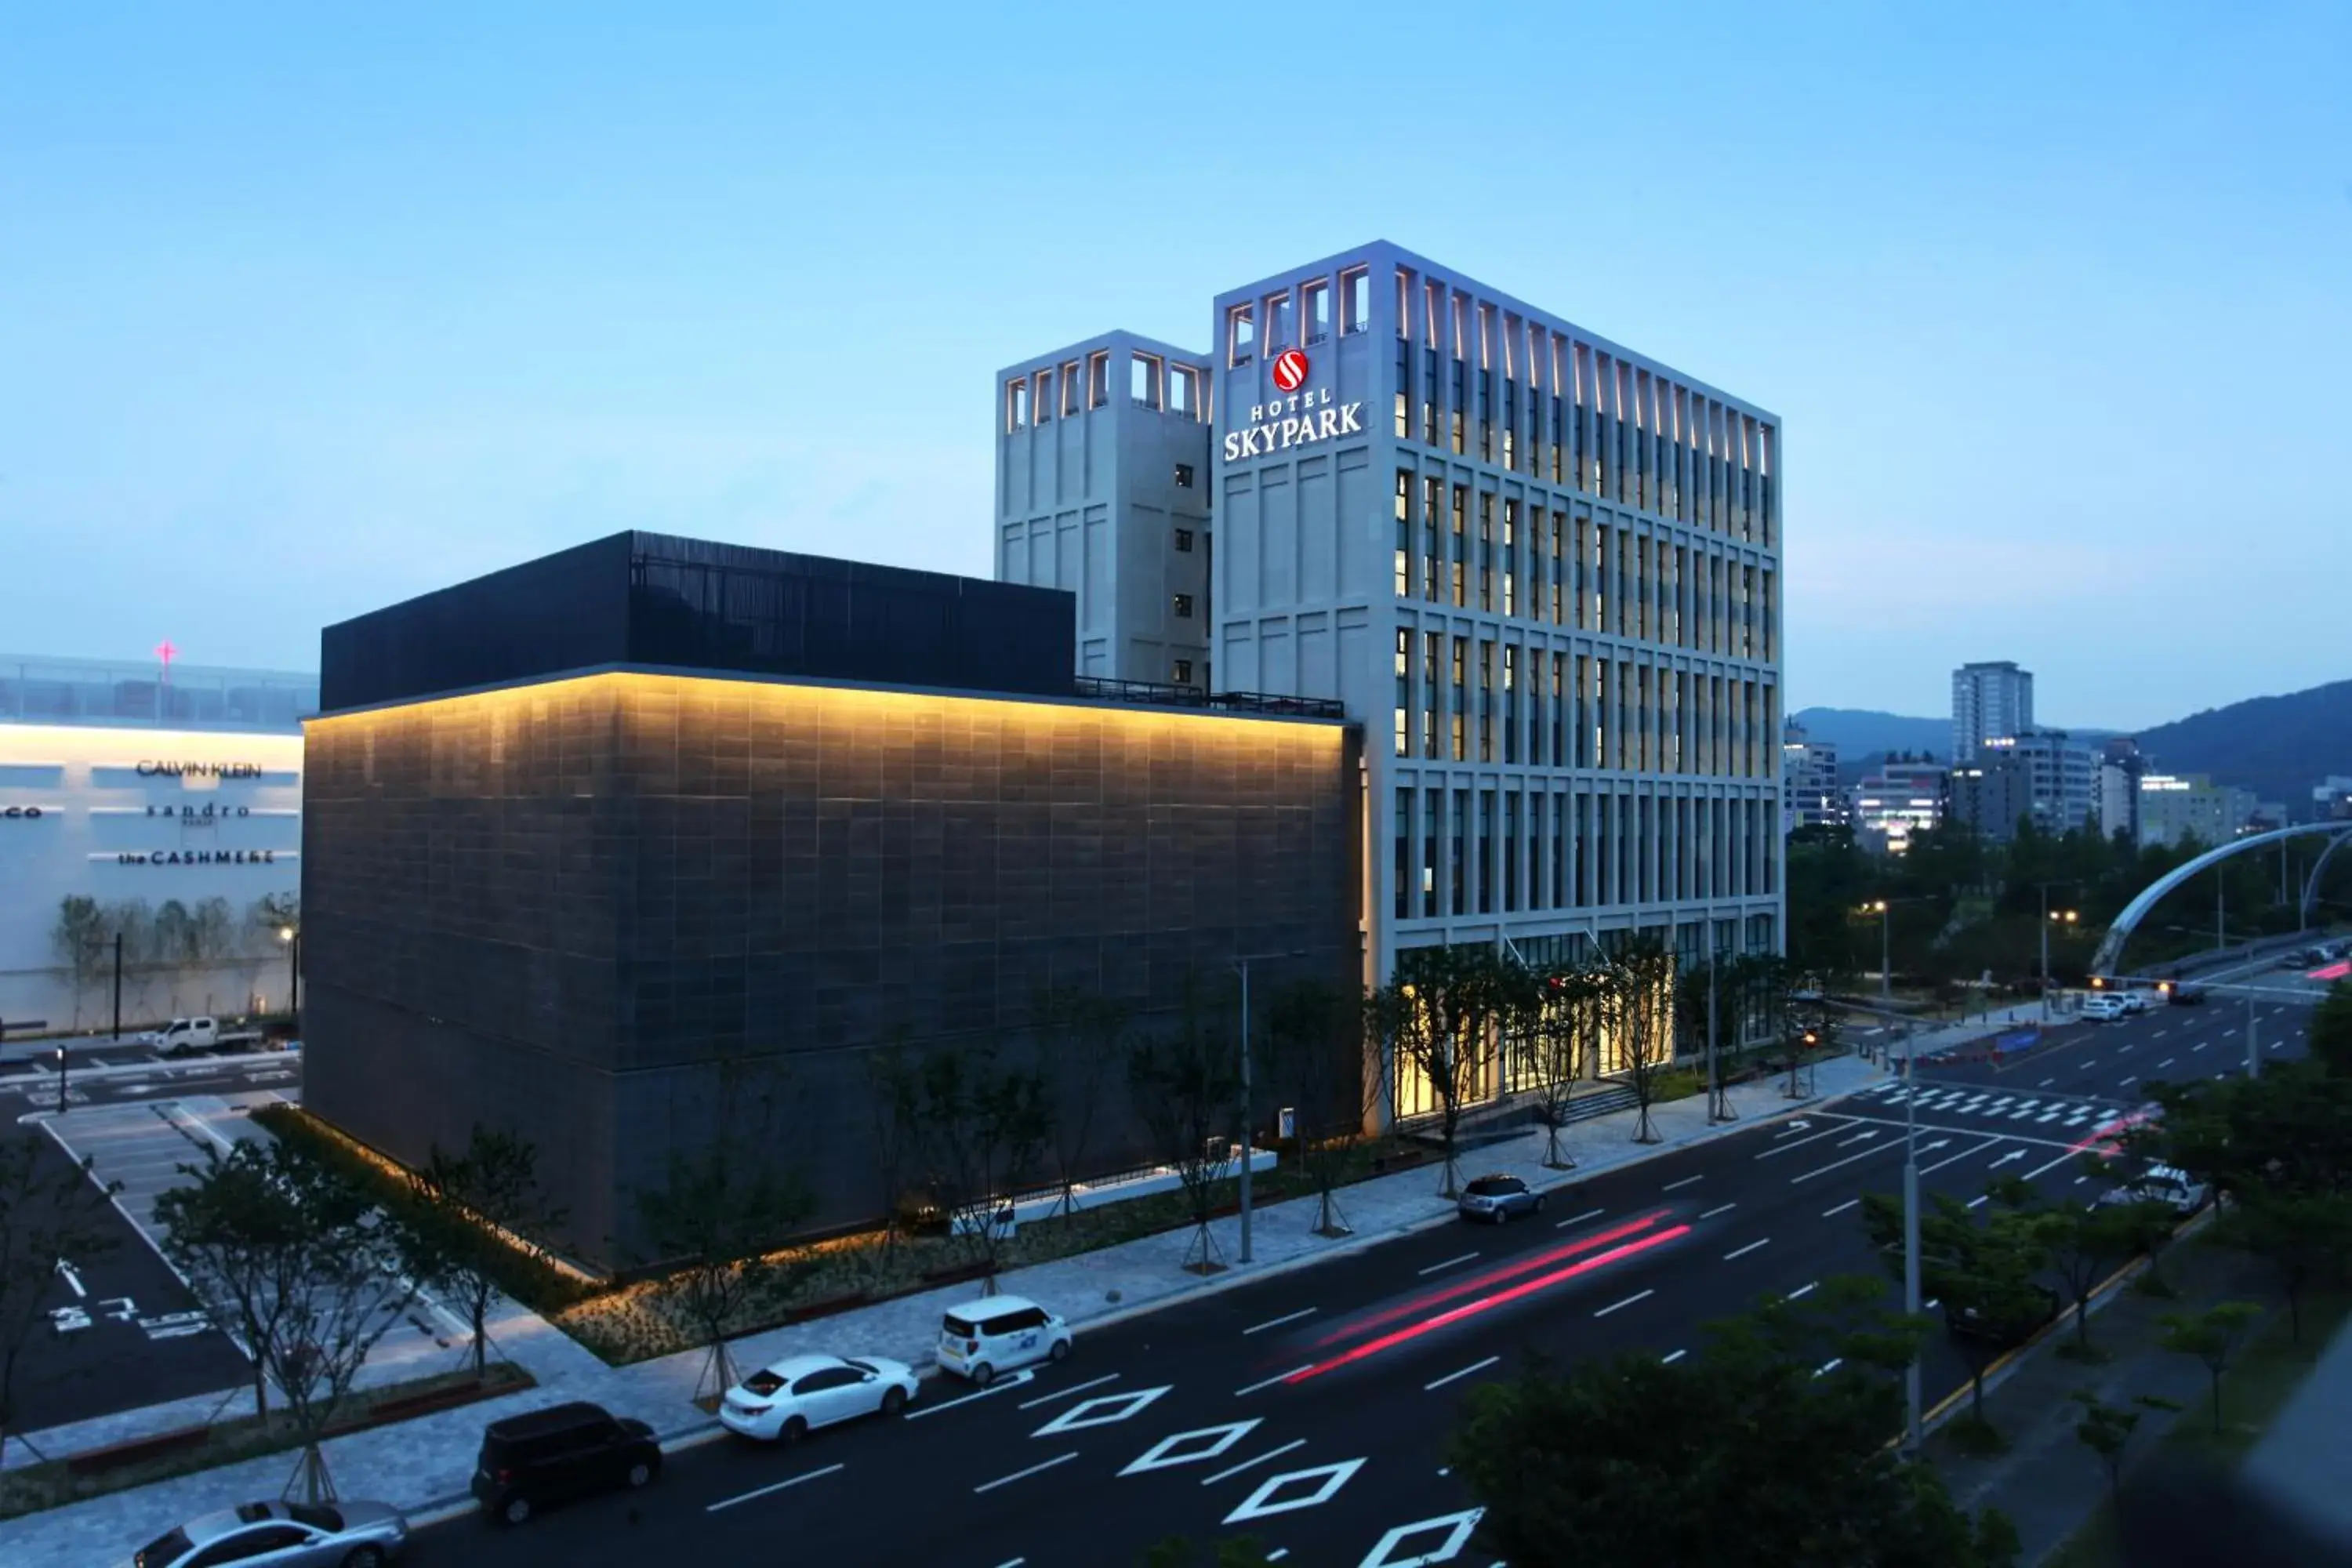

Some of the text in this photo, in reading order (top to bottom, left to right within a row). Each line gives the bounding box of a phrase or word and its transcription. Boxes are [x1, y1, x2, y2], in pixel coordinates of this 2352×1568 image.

[1250, 388, 1331, 422] HOTEL
[1224, 402, 1363, 461] SKYPARK
[136, 760, 261, 779] CALVIN KLEIN
[146, 802, 249, 818] sandro
[118, 851, 274, 865] the CASHMERE
